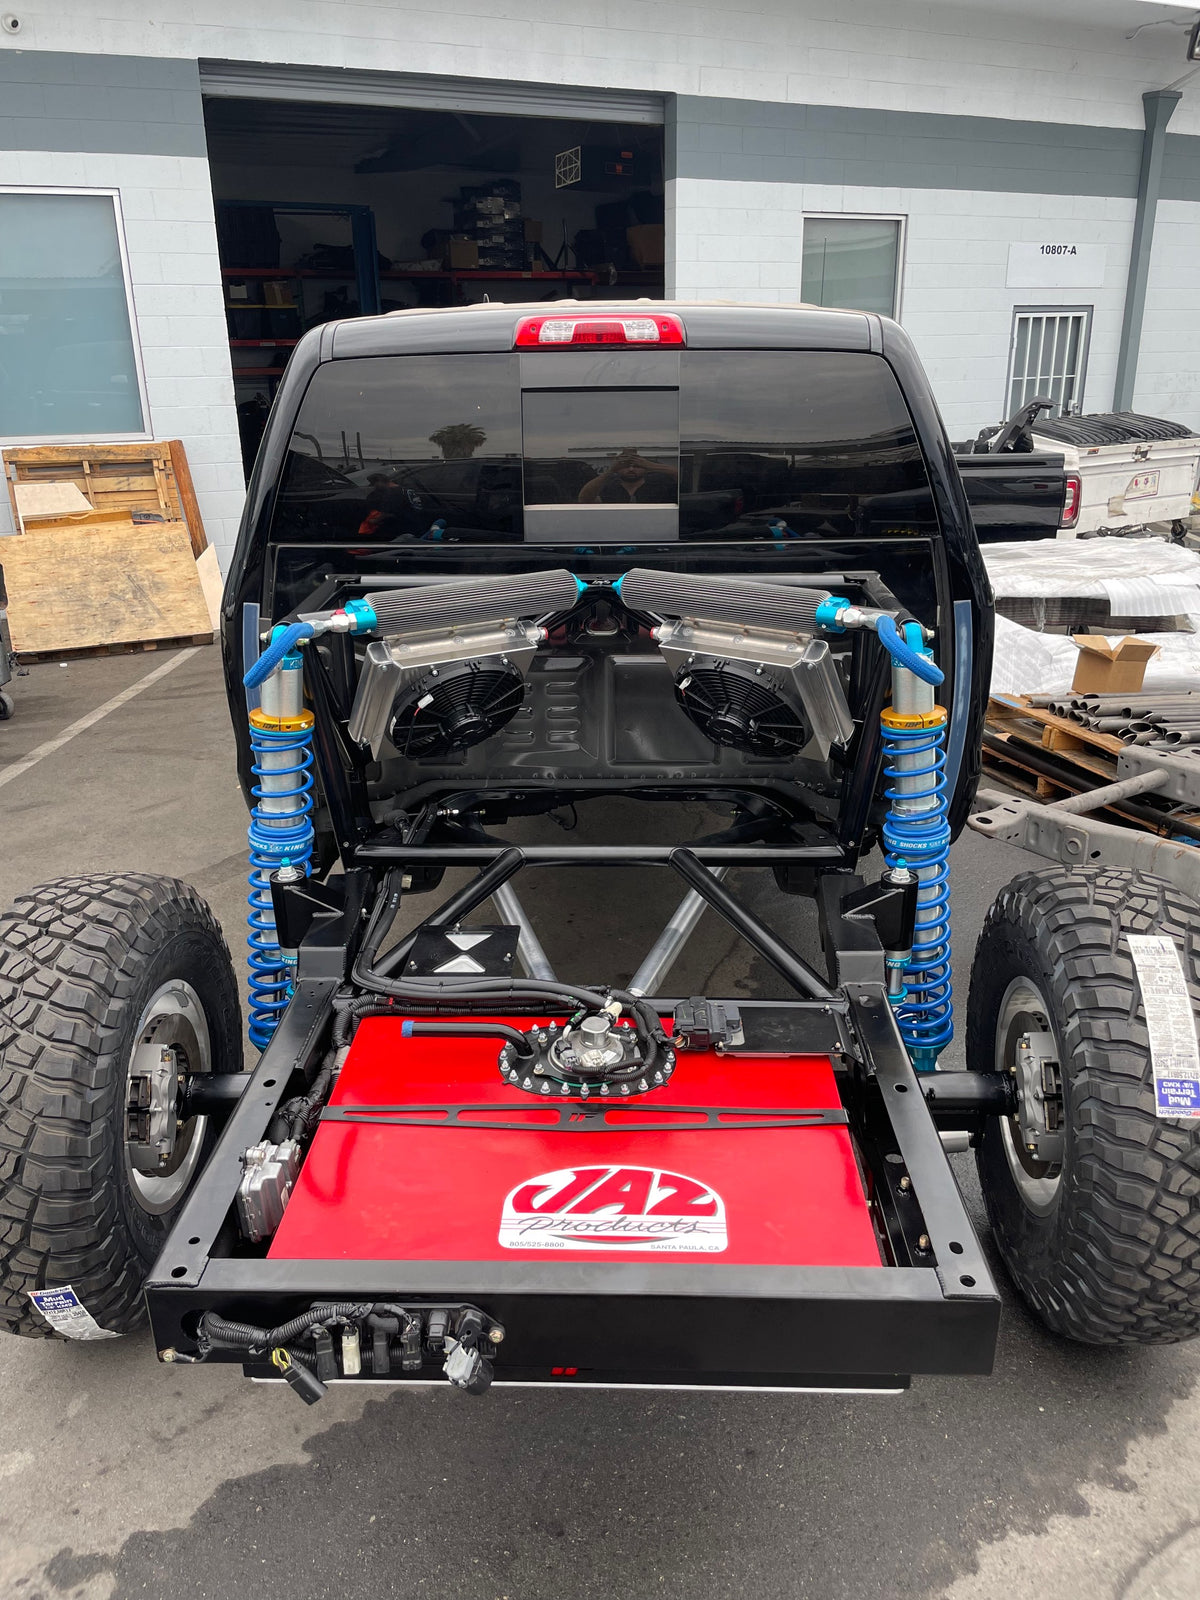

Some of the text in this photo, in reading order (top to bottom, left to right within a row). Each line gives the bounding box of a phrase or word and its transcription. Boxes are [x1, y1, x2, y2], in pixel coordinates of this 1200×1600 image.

[1040, 245, 1077, 255] 10807-A
[249, 840, 305, 851] HOCKS KING
[899, 841, 928, 849] SHOCKS
[1161, 1087, 1197, 1098] Terrain
[1168, 1096, 1191, 1106] Mud
[511, 1167, 718, 1217] JAZ
[517, 1215, 711, 1236] Products
[509, 1240, 565, 1248] 805/525-8800
[40, 1298, 73, 1308] Terrain
[42, 1294, 66, 1303] Mud
